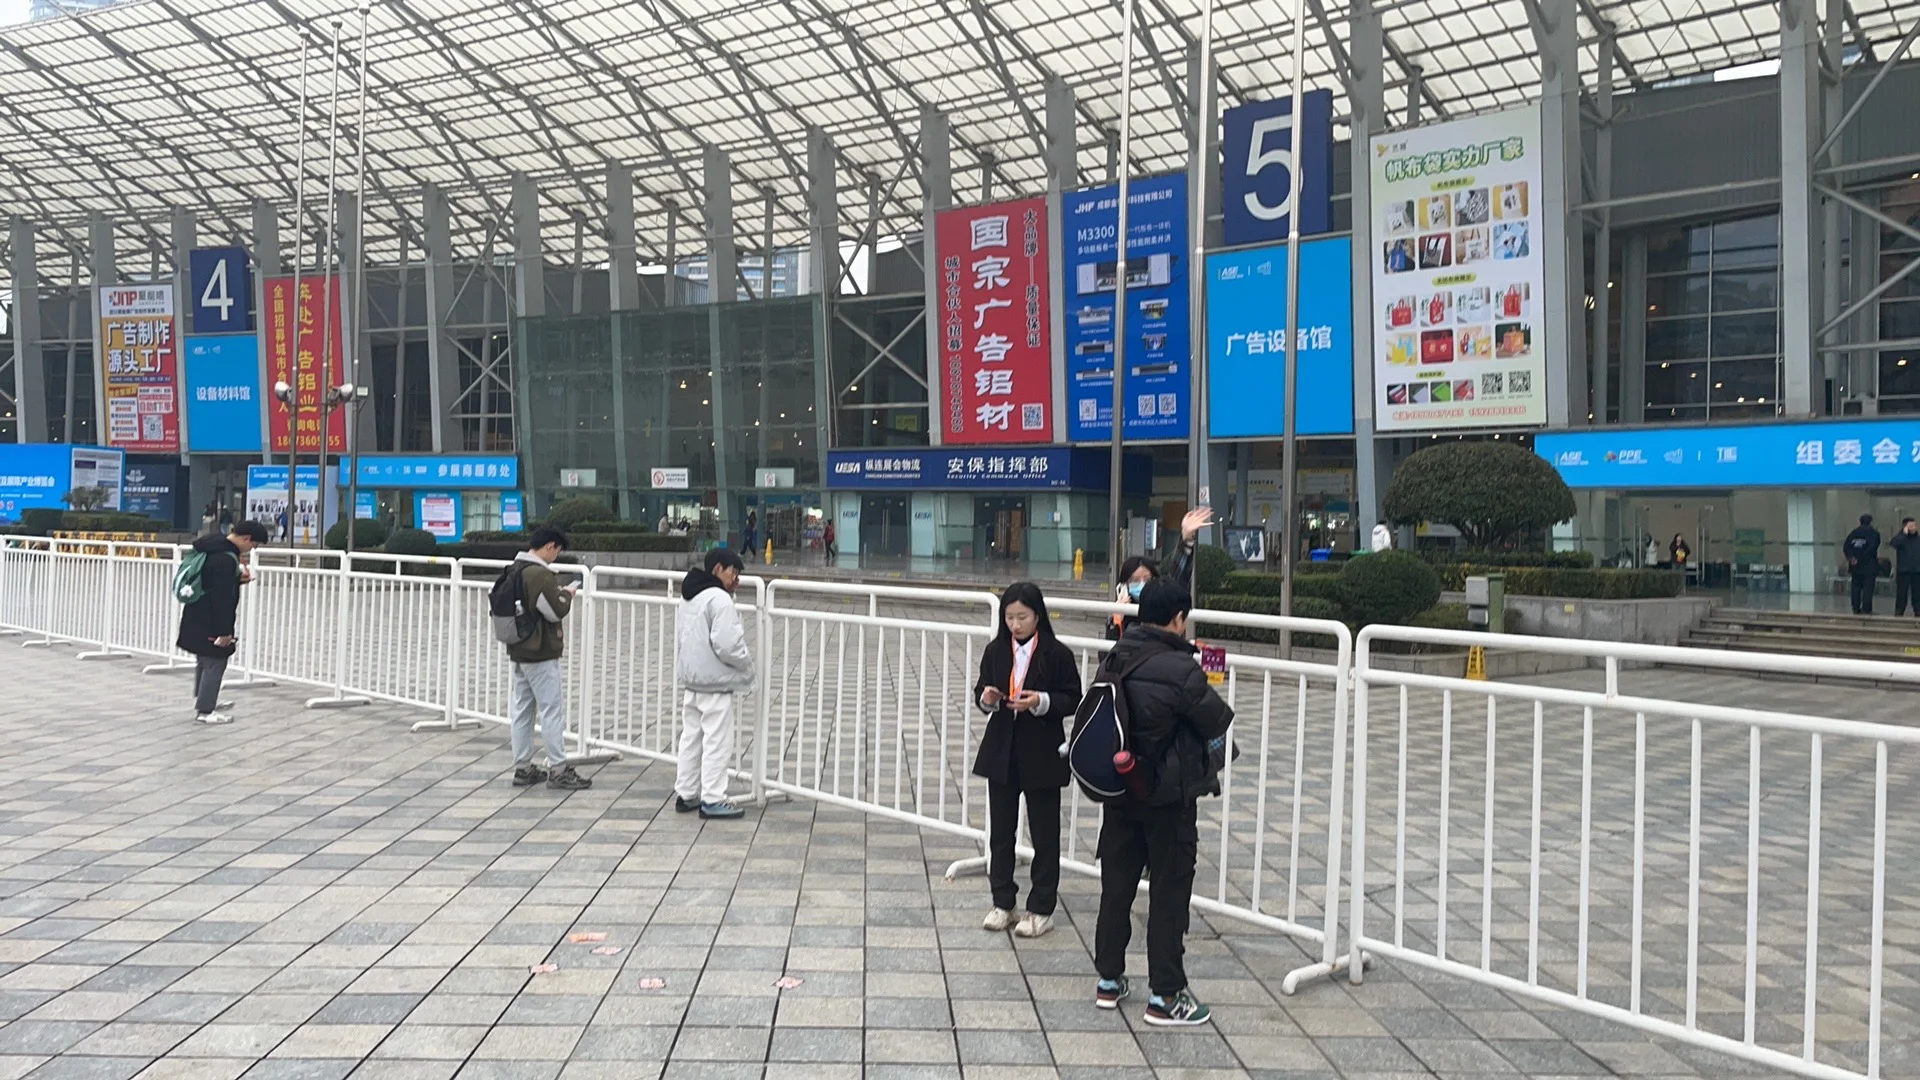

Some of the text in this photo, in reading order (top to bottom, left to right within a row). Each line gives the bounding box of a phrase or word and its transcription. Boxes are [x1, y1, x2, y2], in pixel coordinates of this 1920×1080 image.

[1244, 114, 1304, 220] 5
[1077, 225, 1115, 242] M3300
[201, 259, 234, 321] 4
[107, 320, 170, 346] 广告制作
[970, 215, 1016, 430] 国宗广告铝材
[108, 348, 171, 373] 源头工厂
[274, 284, 289, 413] 全国招募城市合人
[196, 386, 250, 401] 设备材料馆
[438, 463, 510, 477] 参展商服务处
[948, 456, 1048, 473] 安保指挥部
